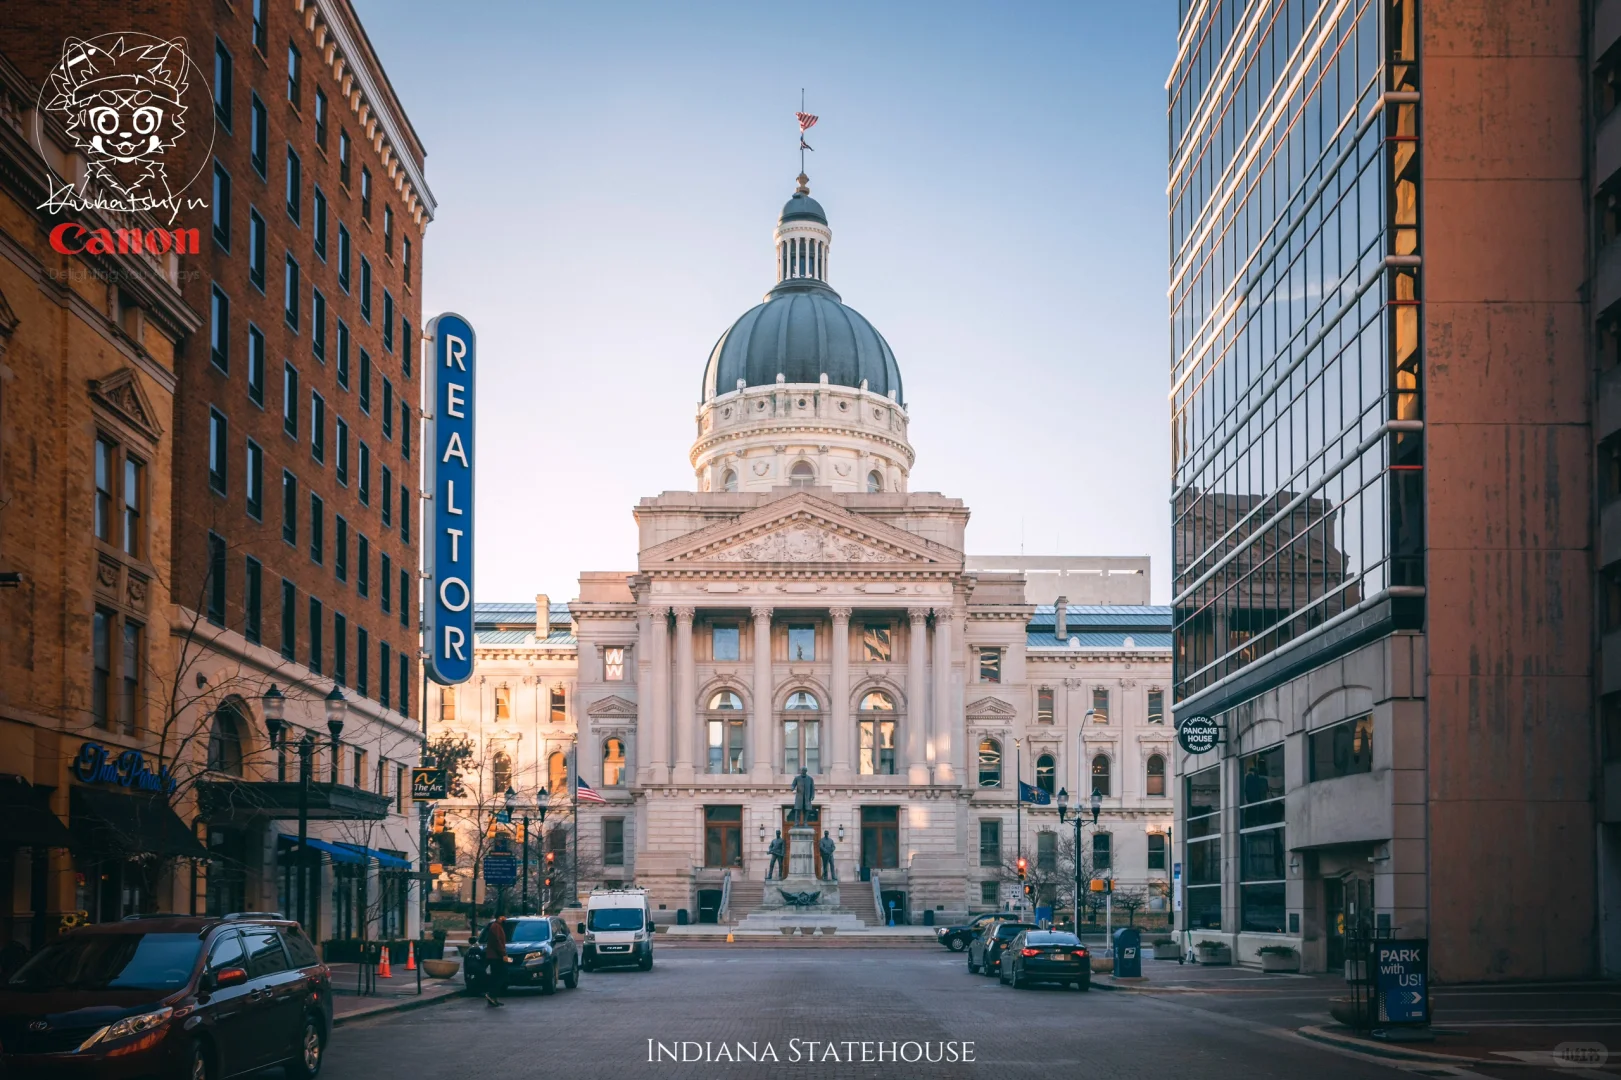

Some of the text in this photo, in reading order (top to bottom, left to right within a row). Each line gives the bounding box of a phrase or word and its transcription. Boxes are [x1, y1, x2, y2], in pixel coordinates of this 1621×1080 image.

[1187, 716, 1213, 726] LINCOLN
[1183, 727, 1218, 735] PANCAKE
[1188, 743, 1212, 752] SQUARE
[414, 783, 443, 791] The Arc
[1380, 949, 1421, 962] PARK
[1380, 963, 1405, 975] with
[1399, 973, 1422, 987] US!
